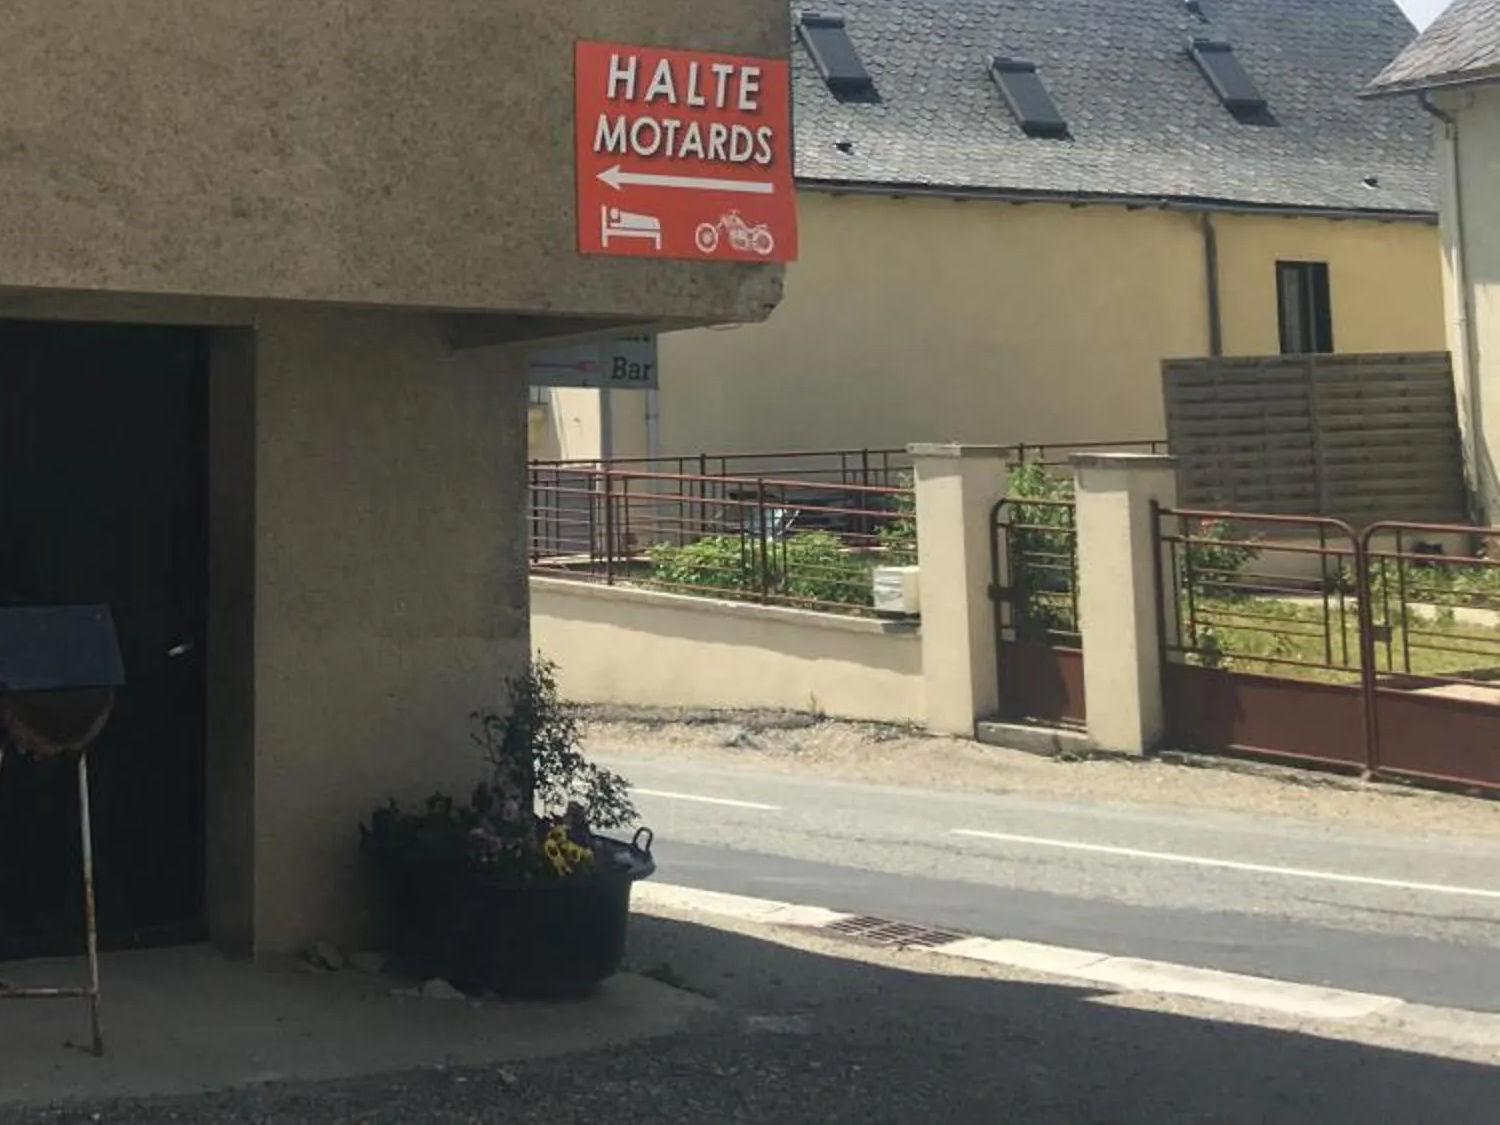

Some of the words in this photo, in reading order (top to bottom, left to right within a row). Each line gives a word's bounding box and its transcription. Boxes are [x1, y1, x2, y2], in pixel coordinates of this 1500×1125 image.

[607, 54, 760, 110] HALTE
[593, 114, 773, 164] MOTARDS
[611, 356, 653, 380] Bar
